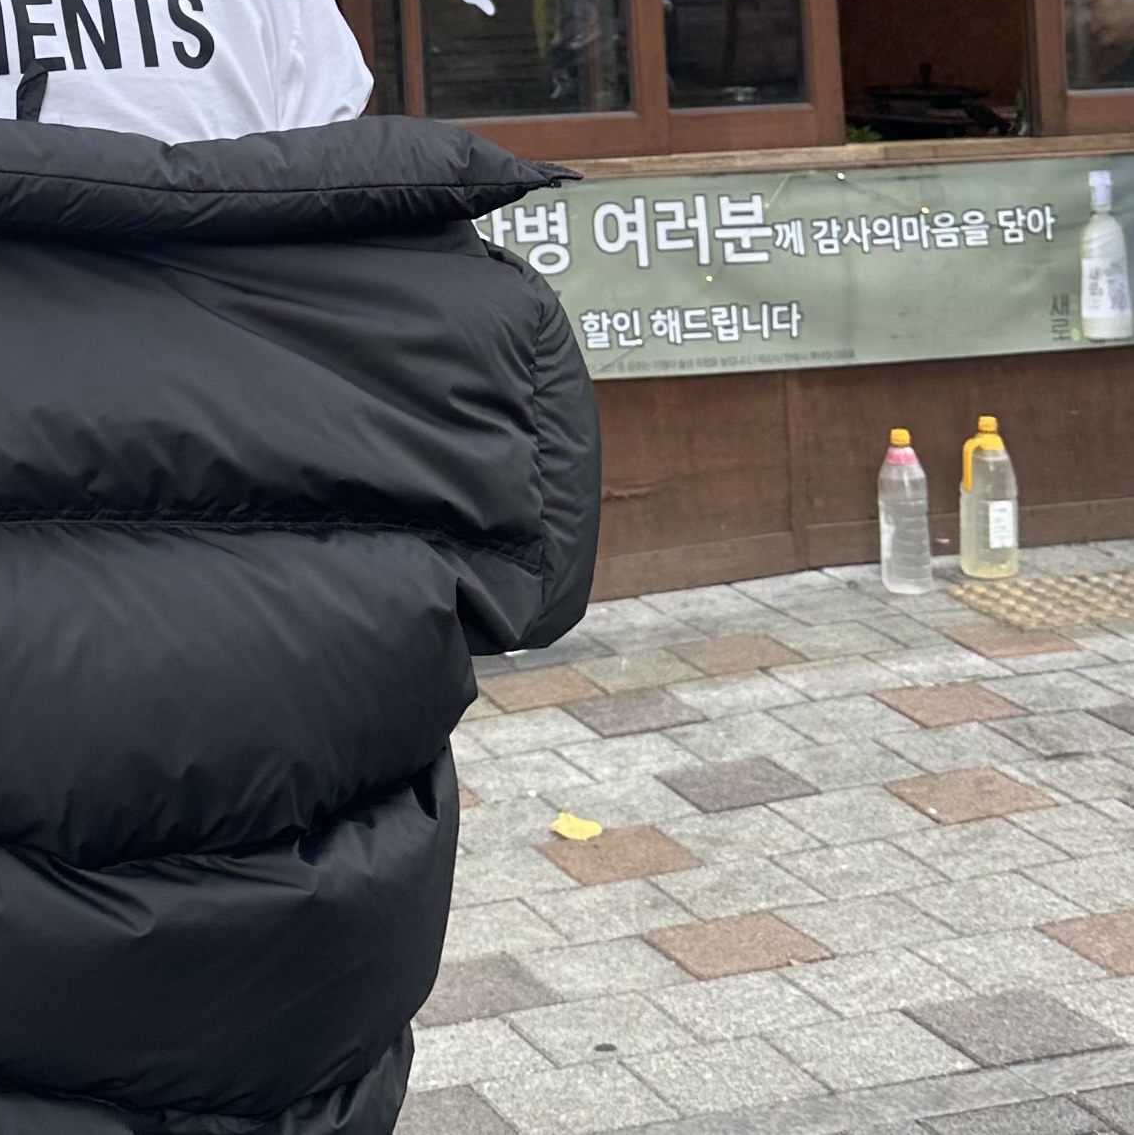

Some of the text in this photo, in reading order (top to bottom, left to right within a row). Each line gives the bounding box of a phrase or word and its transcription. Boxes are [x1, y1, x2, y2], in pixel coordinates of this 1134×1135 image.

[996, 203, 1056, 245] 담아
[580, 301, 803, 349] 할인 해드립니다
